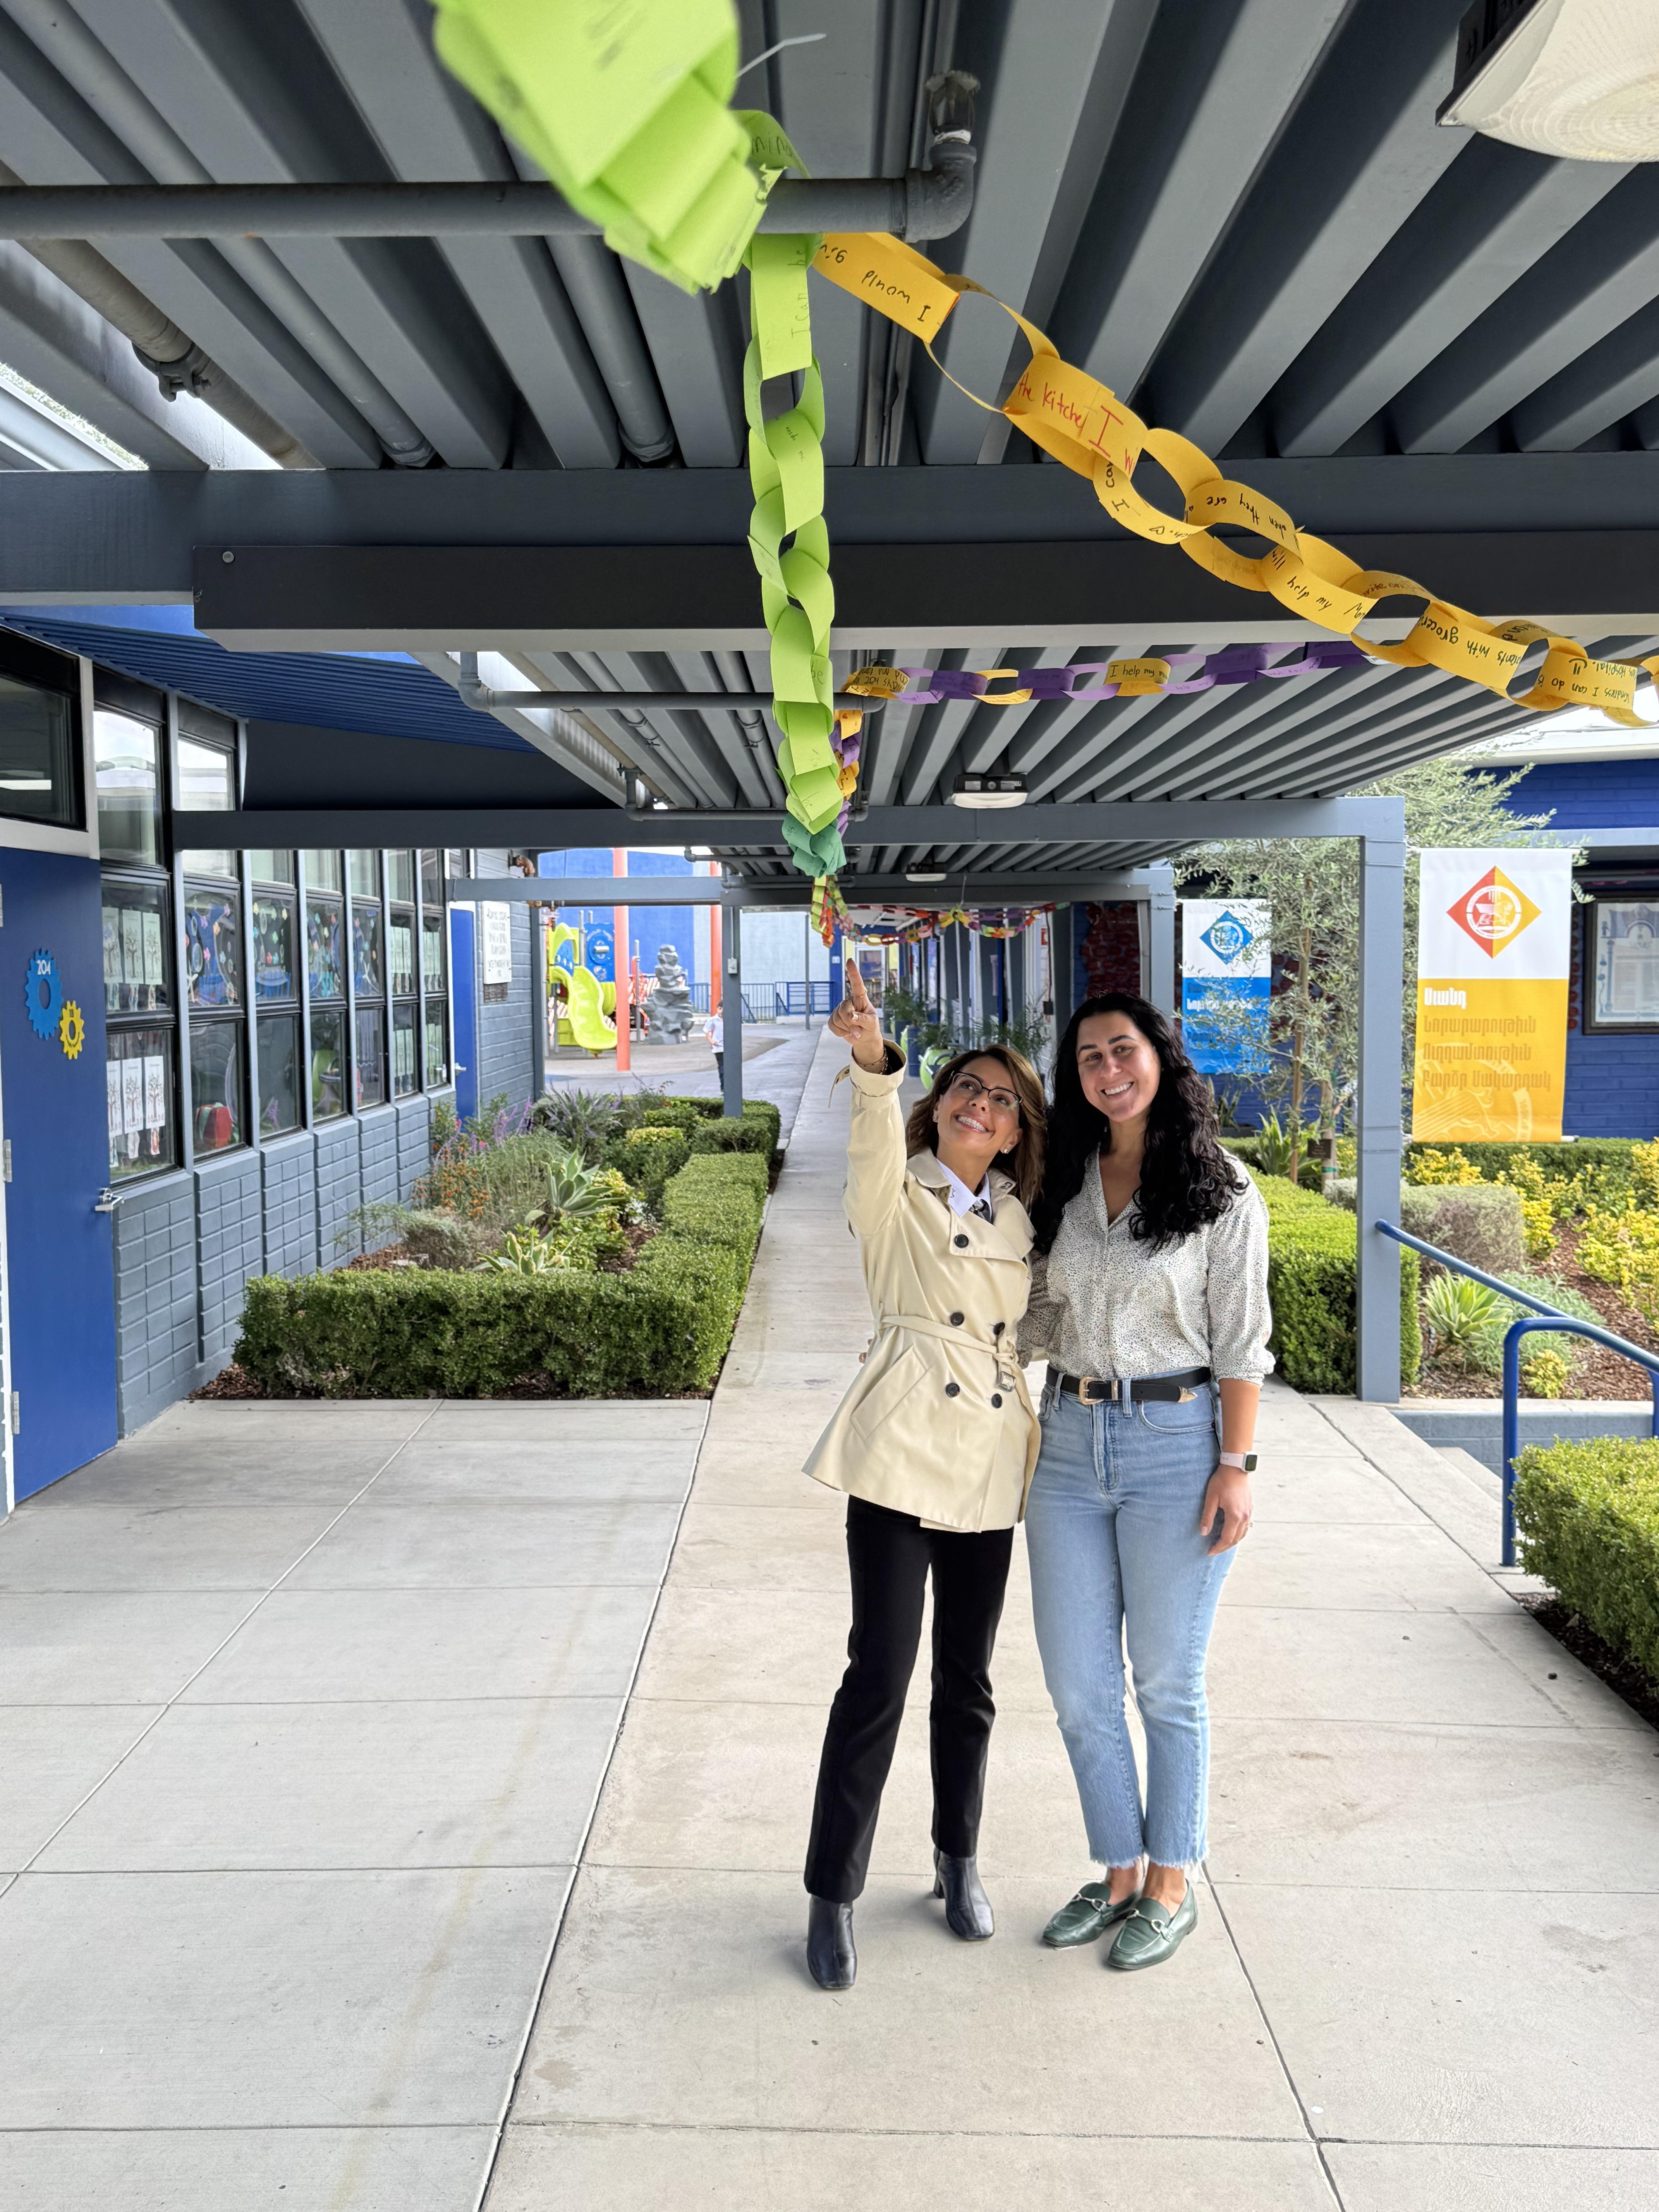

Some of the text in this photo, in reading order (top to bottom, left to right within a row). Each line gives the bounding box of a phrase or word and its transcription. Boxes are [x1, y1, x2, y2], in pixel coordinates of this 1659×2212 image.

[861, 270, 910, 304] would
[917, 305, 931, 322] I
[1088, 405, 1123, 458] I
[1111, 498, 1130, 512] I
[1206, 496, 1227, 507] are
[1239, 493, 1259, 526] they
[1287, 576, 1310, 599] help
[1316, 597, 1332, 611] my
[1467, 641, 1490, 658] with
[1109, 665, 1120, 678] I
[1122, 663, 1140, 678] help
[1144, 668, 1155, 678] my
[1551, 677, 1565, 690] do
[1571, 683, 1588, 694] can
[1592, 687, 1599, 697] I
[37, 960, 51, 975] 204
